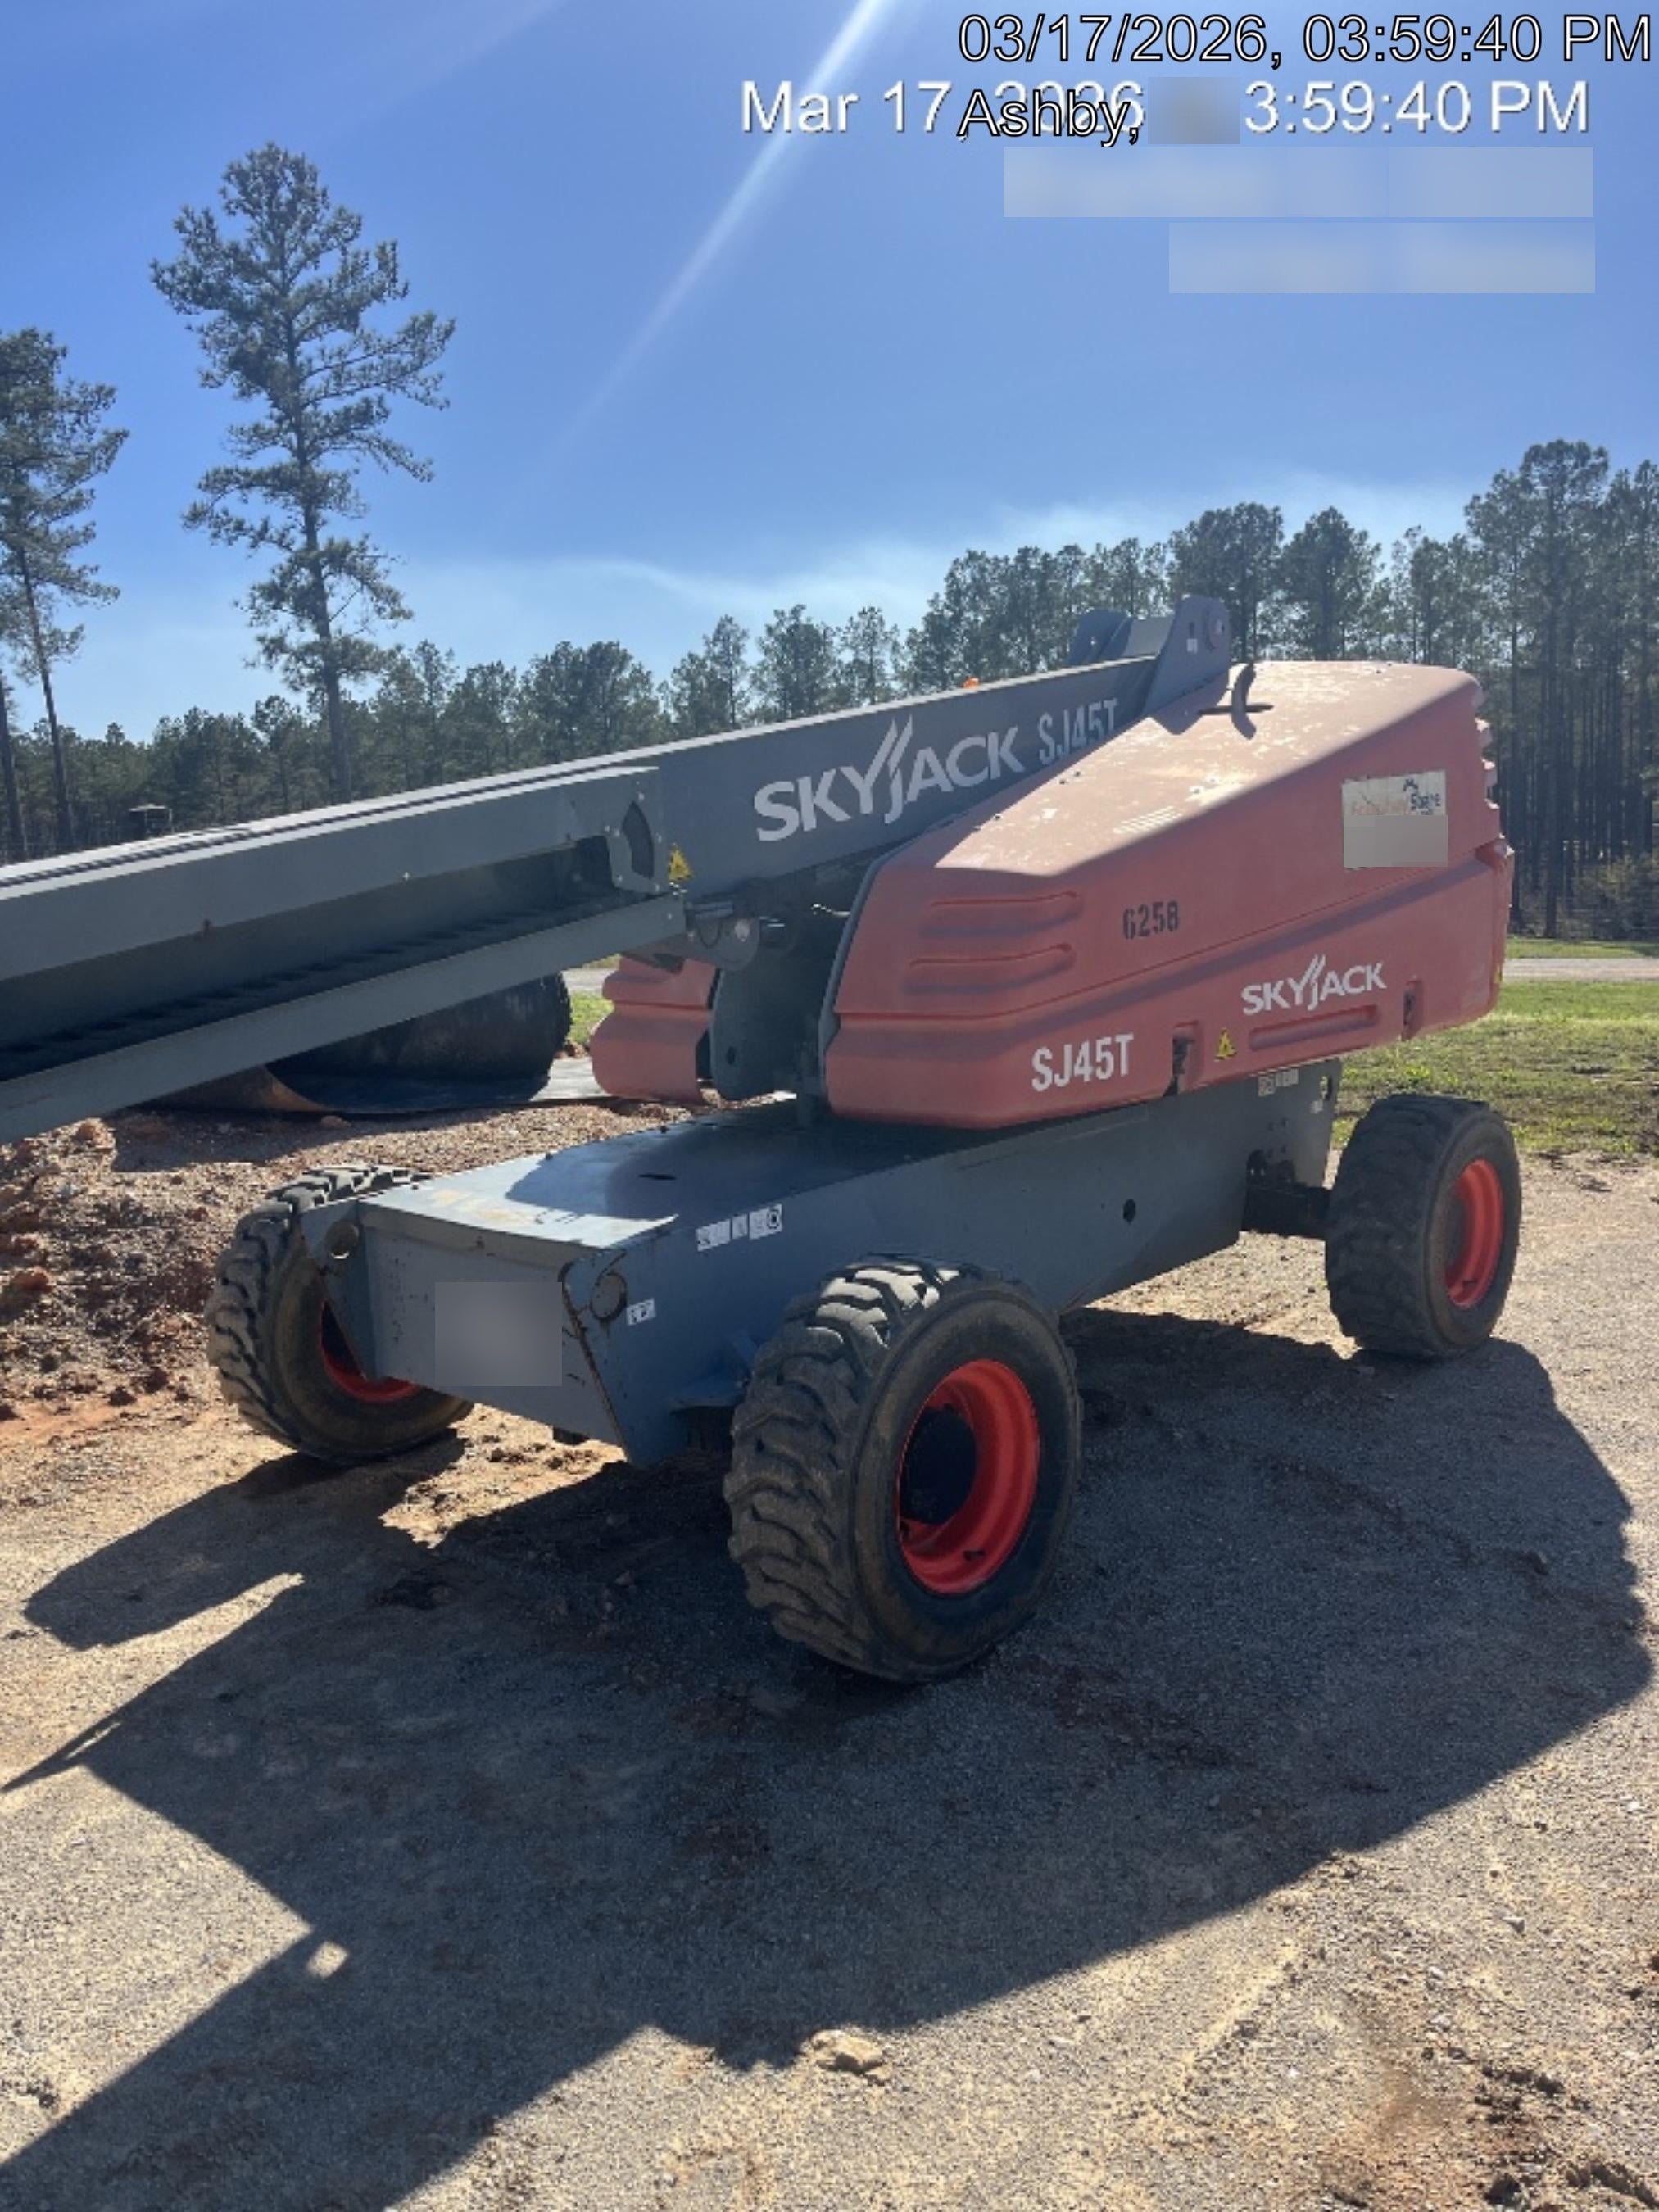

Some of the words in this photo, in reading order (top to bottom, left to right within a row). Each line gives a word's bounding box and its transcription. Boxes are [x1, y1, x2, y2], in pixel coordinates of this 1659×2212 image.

[753, 714, 1025, 842] SKYJACK
[1122, 900, 1181, 940] 6258
[1241, 954, 1387, 1017] SKYJACK
[1031, 1032, 1135, 1092] SJ45T
